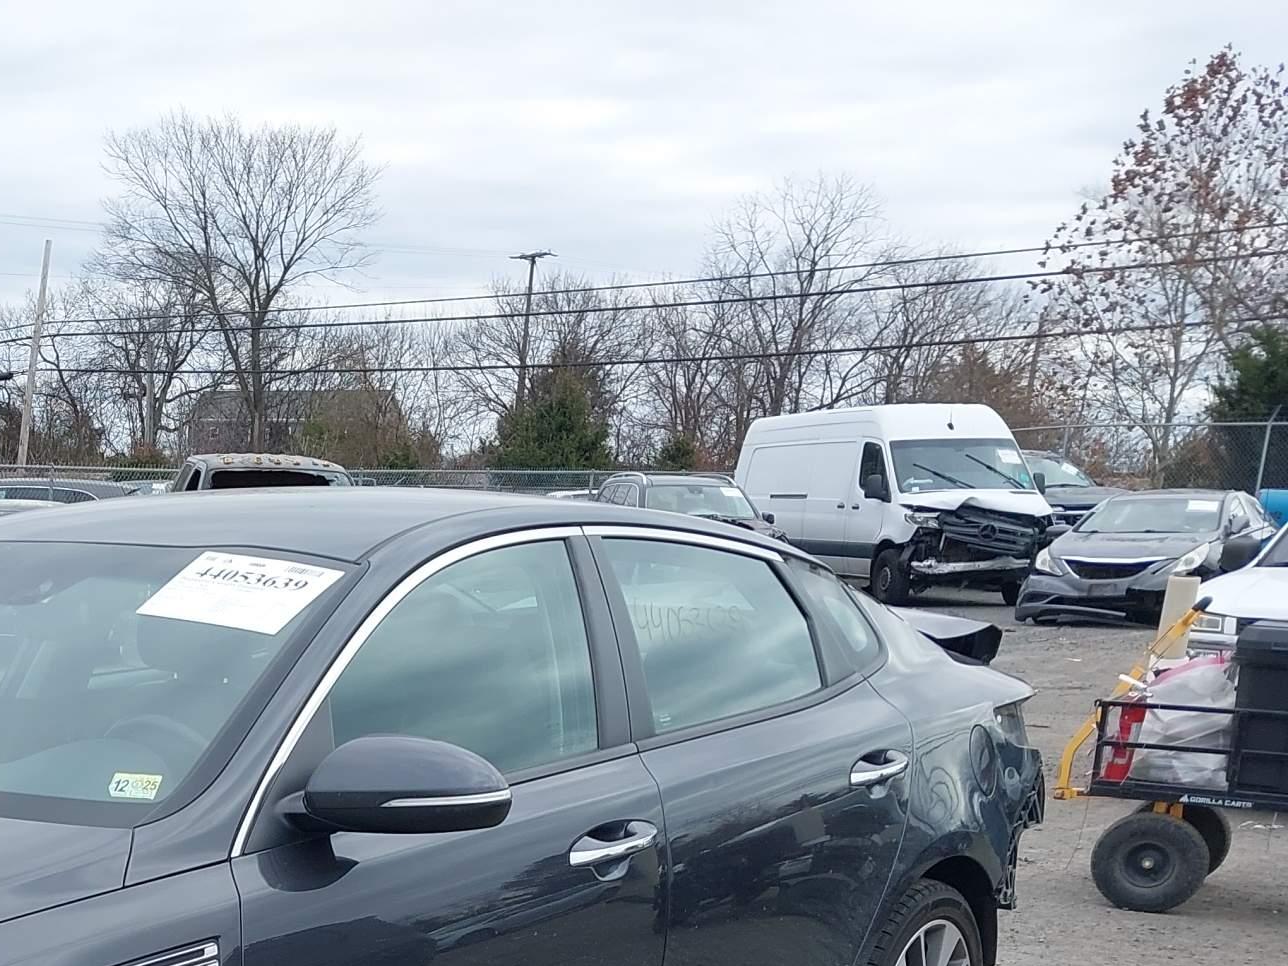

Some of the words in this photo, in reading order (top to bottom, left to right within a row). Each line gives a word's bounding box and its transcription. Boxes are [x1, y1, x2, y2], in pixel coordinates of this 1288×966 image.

[195, 565, 309, 591] 44053639
[113, 778, 130, 793] 12
[142, 779, 159, 792] 25
[1189, 796, 1223, 806] GORILLA
